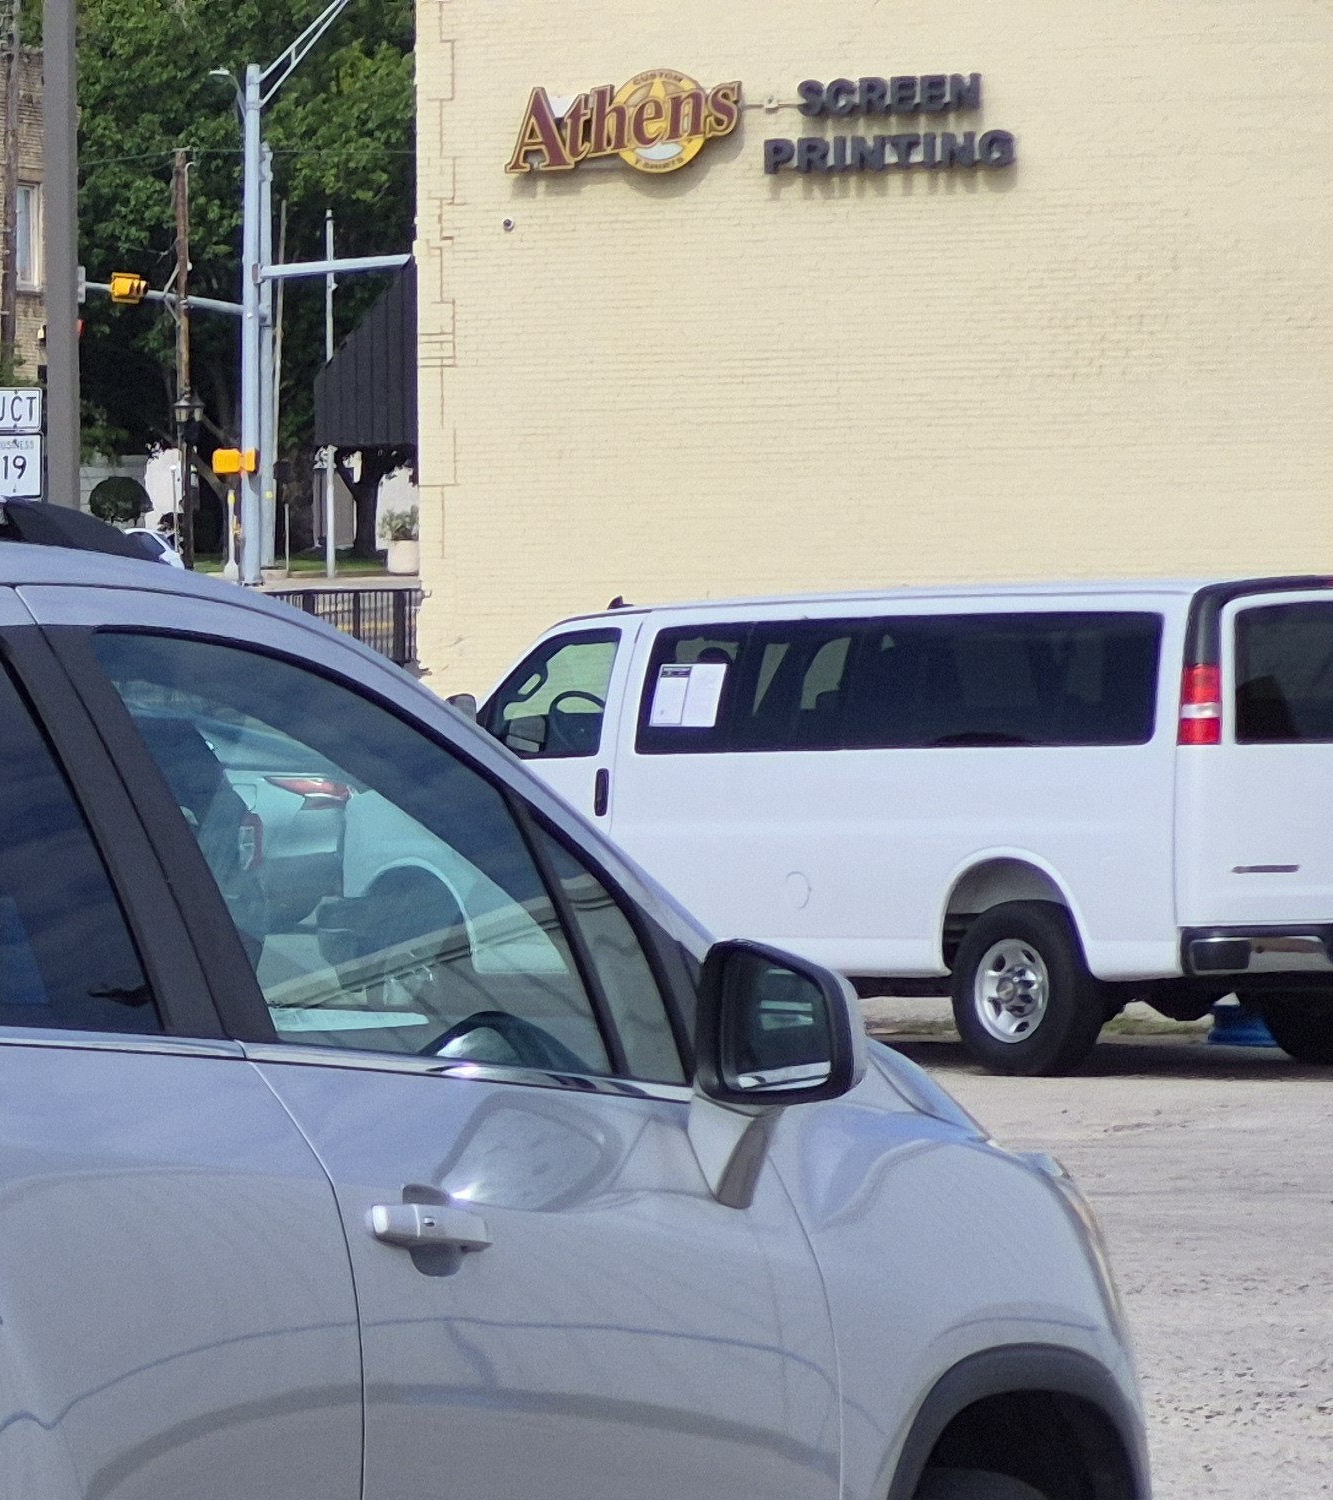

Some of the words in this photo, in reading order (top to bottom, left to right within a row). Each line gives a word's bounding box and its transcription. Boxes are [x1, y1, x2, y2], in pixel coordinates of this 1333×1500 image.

[632, 71, 684, 85] CUSTOM
[797, 72, 983, 117] SCREEN
[504, 80, 743, 173] Athens
[764, 129, 1017, 175] PRINTING
[2, 455, 28, 480] 19
